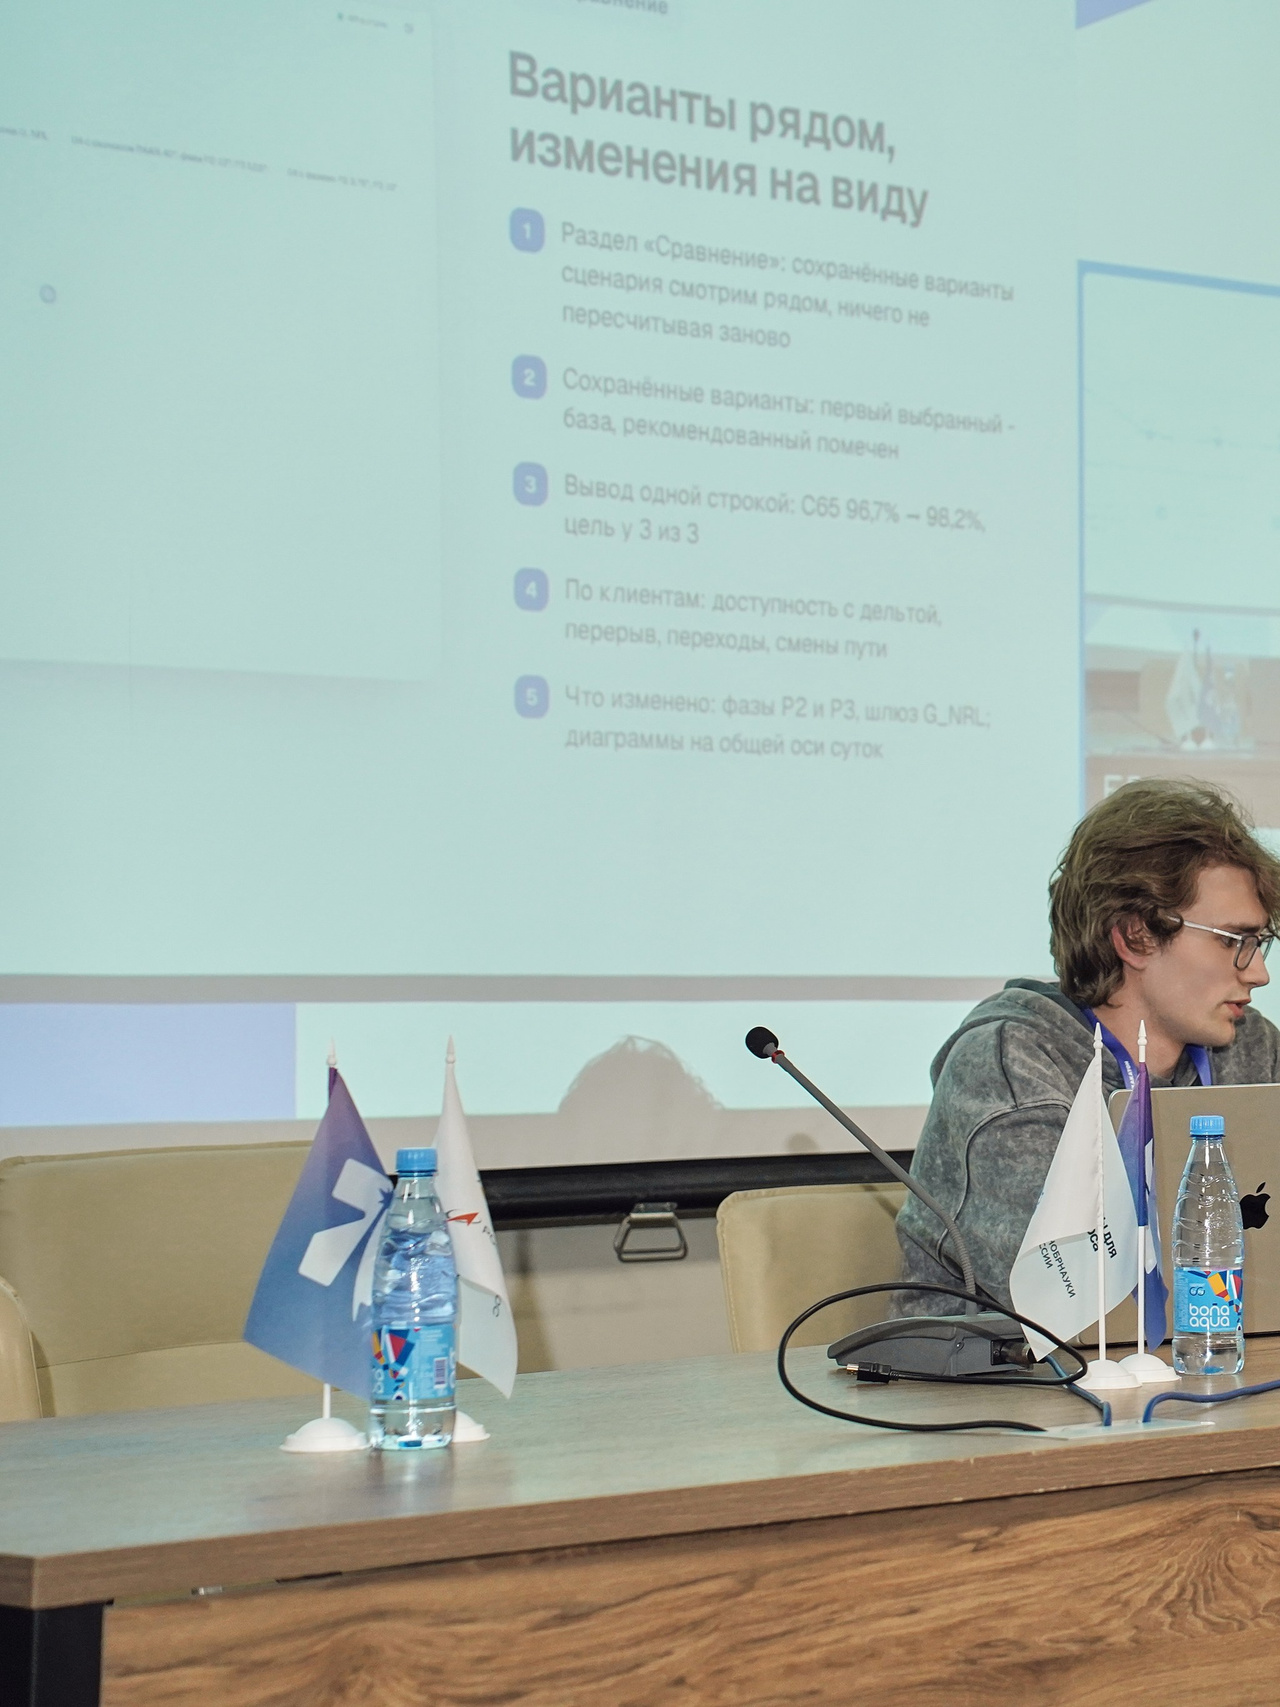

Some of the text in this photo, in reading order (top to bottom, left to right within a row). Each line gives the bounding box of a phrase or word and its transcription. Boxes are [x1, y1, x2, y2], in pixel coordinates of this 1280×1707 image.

[508, 49, 896, 164] Варианты рядом,
[509, 126, 929, 229] изменения на виду
[522, 221, 533, 240] 1
[561, 221, 638, 252] Раздел
[791, 256, 919, 290] сохранённые
[924, 275, 1014, 301] варианты
[561, 265, 930, 328] сценария смотрим рядом, ничего не
[562, 305, 791, 349] пересчитывая заново
[523, 369, 536, 386] 2
[562, 367, 705, 404] Сохранённые
[710, 388, 814, 414] варианты:
[820, 399, 892, 422] первый
[897, 407, 1003, 434] выбранный
[563, 407, 899, 459] база, рекомендованный помечен
[525, 476, 537, 494] 3
[564, 473, 634, 503] Вывод
[639, 485, 701, 506] одной
[707, 491, 795, 514] строкой:
[564, 517, 699, 544] цель у 3 из 3
[525, 577, 942, 627] 4 По клиентам: доступность с дельтой,
[565, 622, 887, 661] перерыв, переходы, смены пути
[526, 688, 538, 706] 5
[565, 685, 605, 708] Что
[611, 692, 715, 713] изменено:
[722, 695, 775, 717] фазы
[813, 703, 824, 718] и
[865, 705, 919, 723] шлюз
[564, 729, 883, 761] диаграммы на общей оси суток
[1048, 1239, 1077, 1298] ОБРНАУКИ
[1189, 1303, 1230, 1316] bona
[1189, 1316, 1230, 1329] aqua
